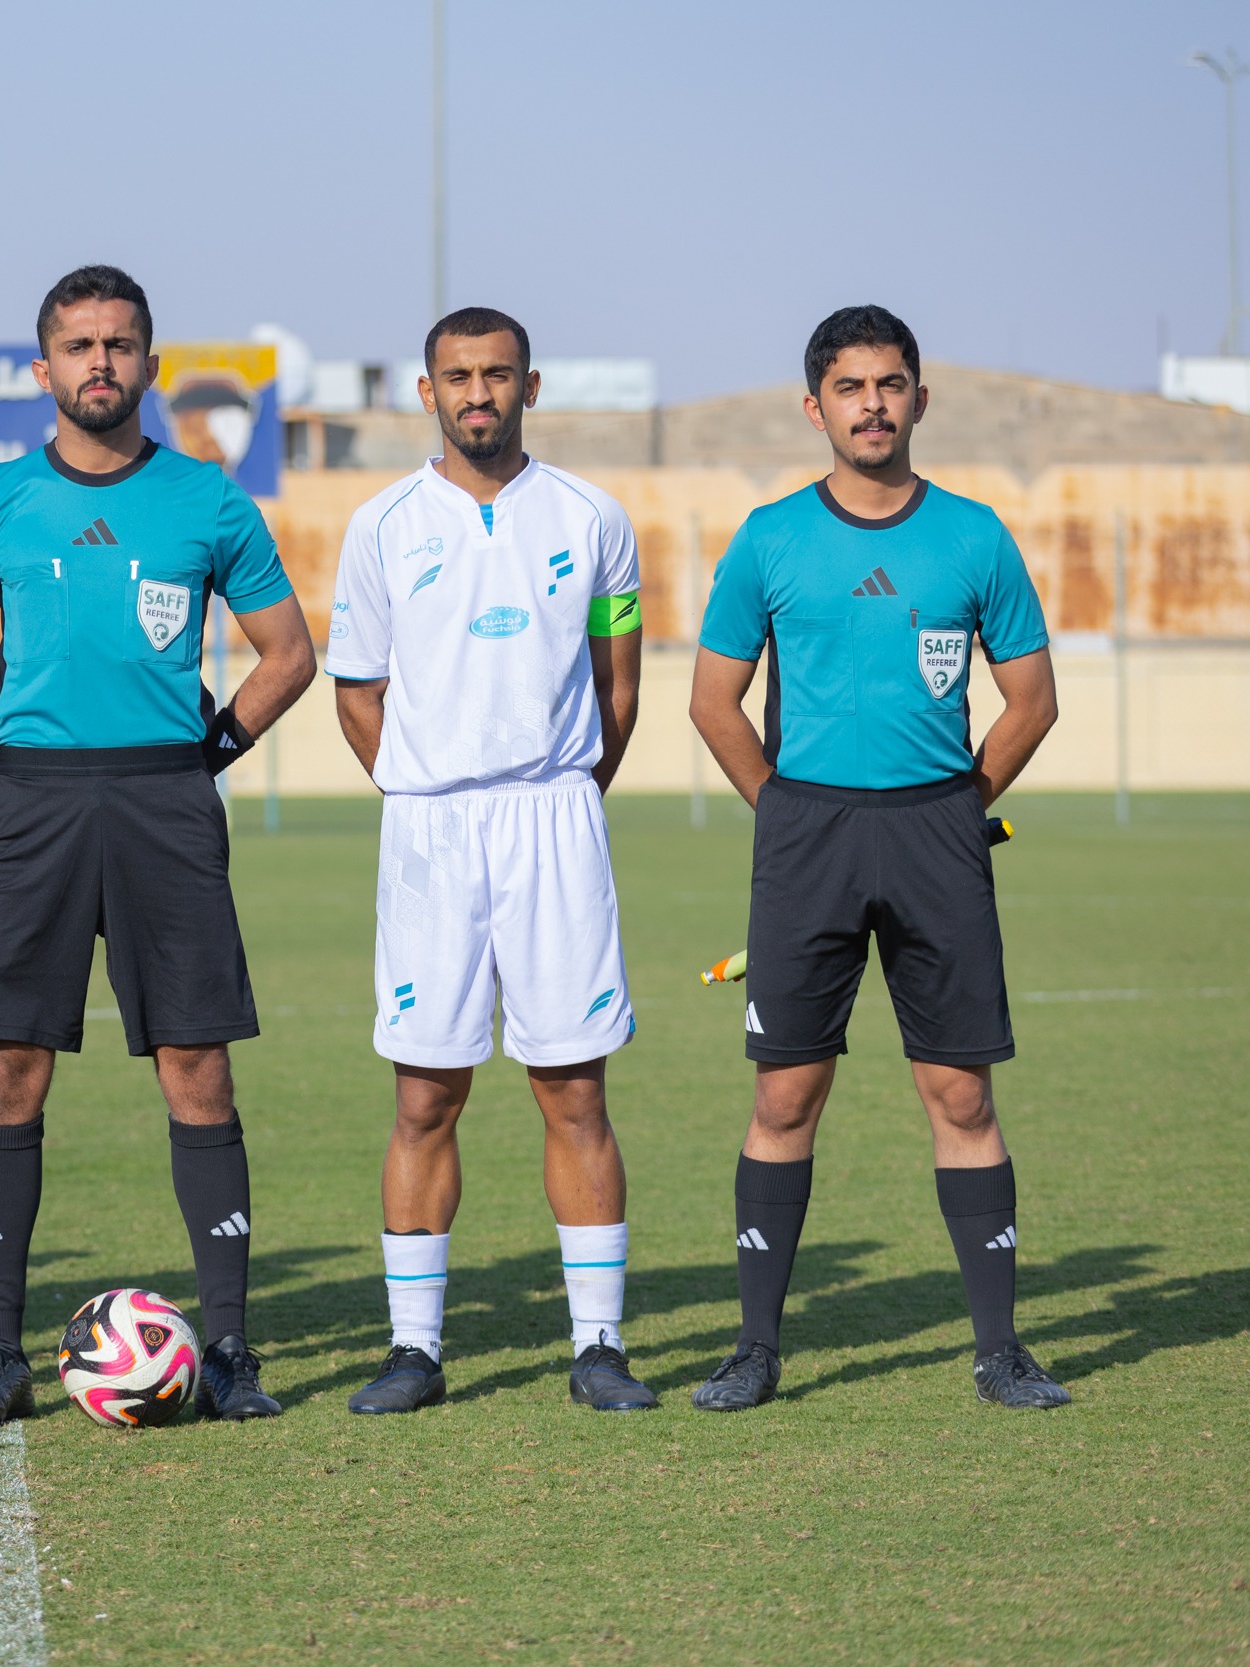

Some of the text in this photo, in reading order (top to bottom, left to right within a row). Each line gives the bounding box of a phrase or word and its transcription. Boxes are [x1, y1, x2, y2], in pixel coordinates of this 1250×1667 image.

[144, 589, 186, 610] SAFF
[146, 608, 180, 621] REFEREE
[923, 638, 963, 655] SAFF
[926, 658, 958, 667] REFEREE
